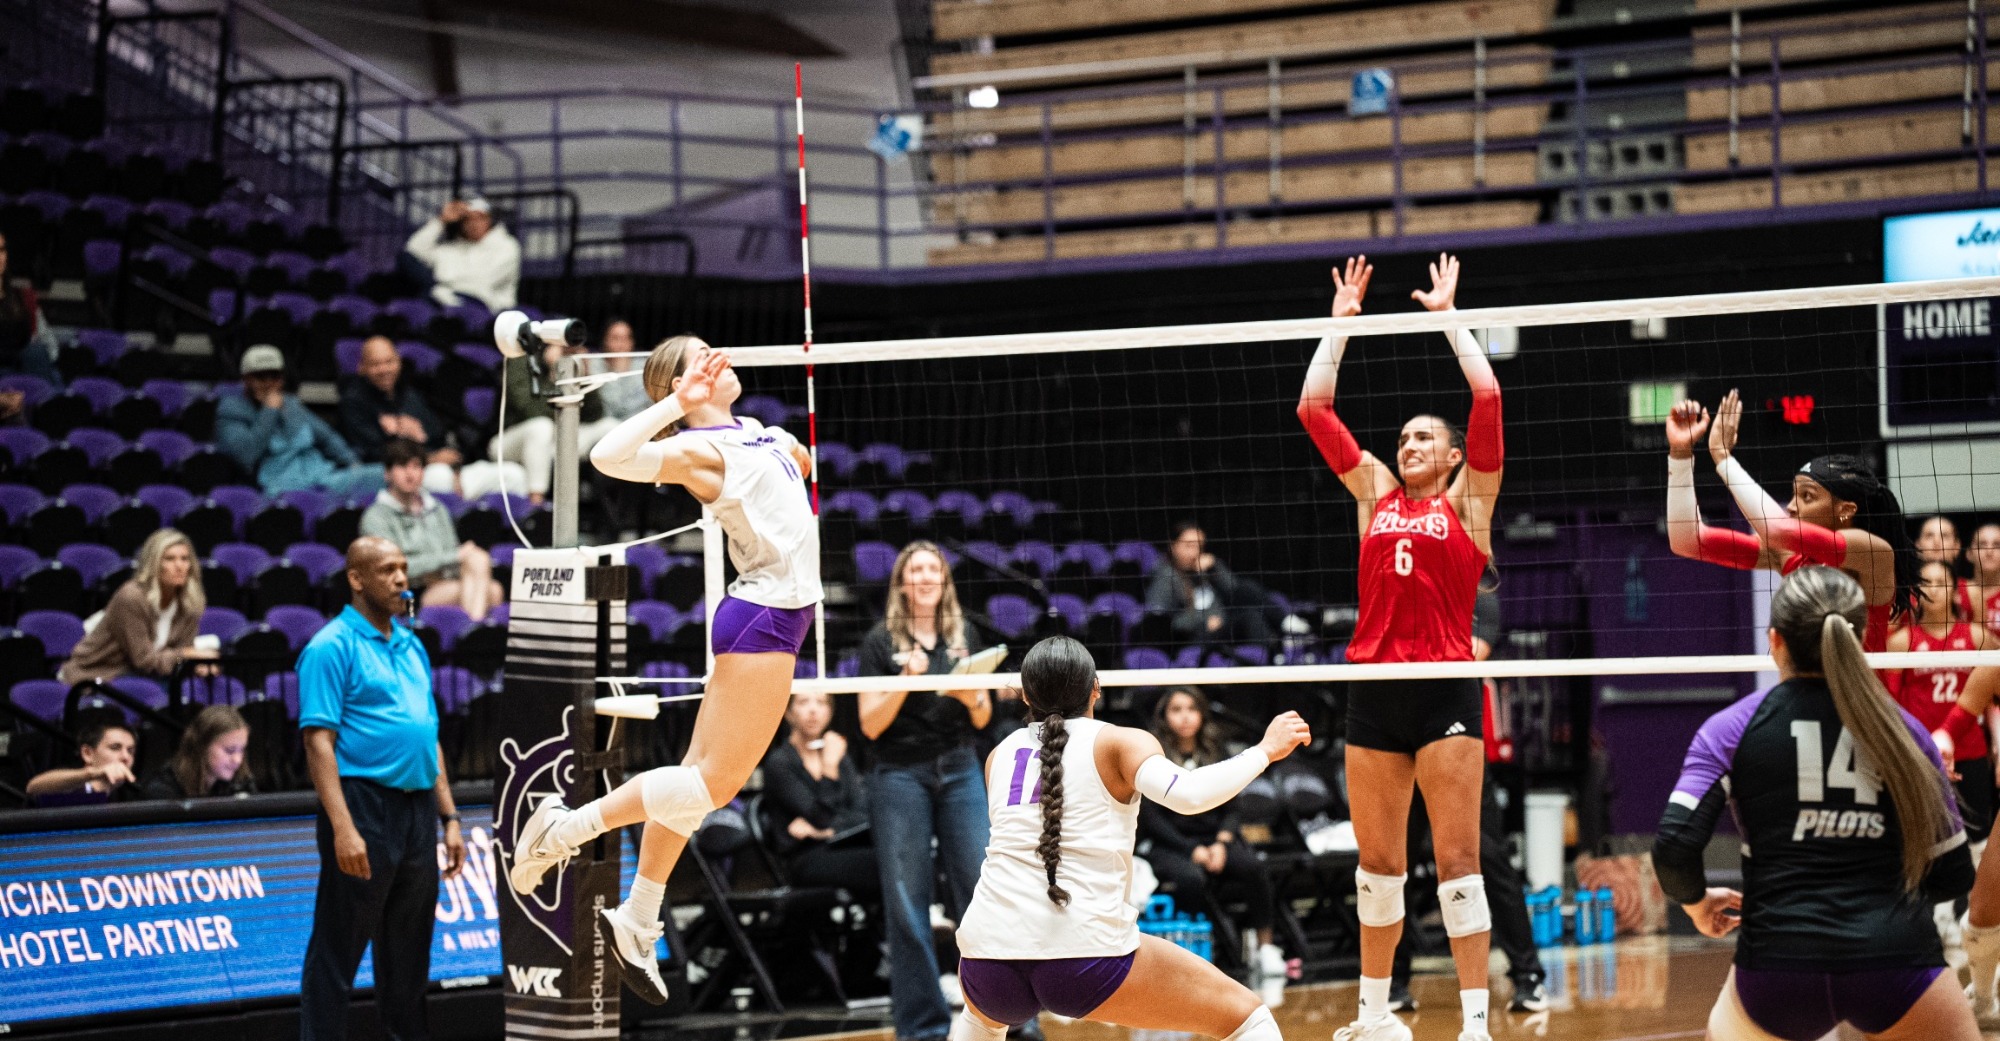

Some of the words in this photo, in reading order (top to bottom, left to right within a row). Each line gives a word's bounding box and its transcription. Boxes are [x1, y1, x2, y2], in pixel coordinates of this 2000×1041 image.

[1903, 300, 1991, 340] HOME
[1395, 538, 1413, 575] 6
[522, 567, 575, 584] PORTLAND
[530, 582, 563, 598] PILOTS
[1931, 672, 1959, 704] 22
[1790, 719, 1884, 805] 14
[1792, 809, 1886, 841] PILOTS
[80, 865, 265, 911] DOWNTOWN
[0, 927, 103, 969] HOTEL
[103, 915, 239, 959] PARTNER
[507, 965, 562, 998] WCC
[590, 959, 605, 1032] import
